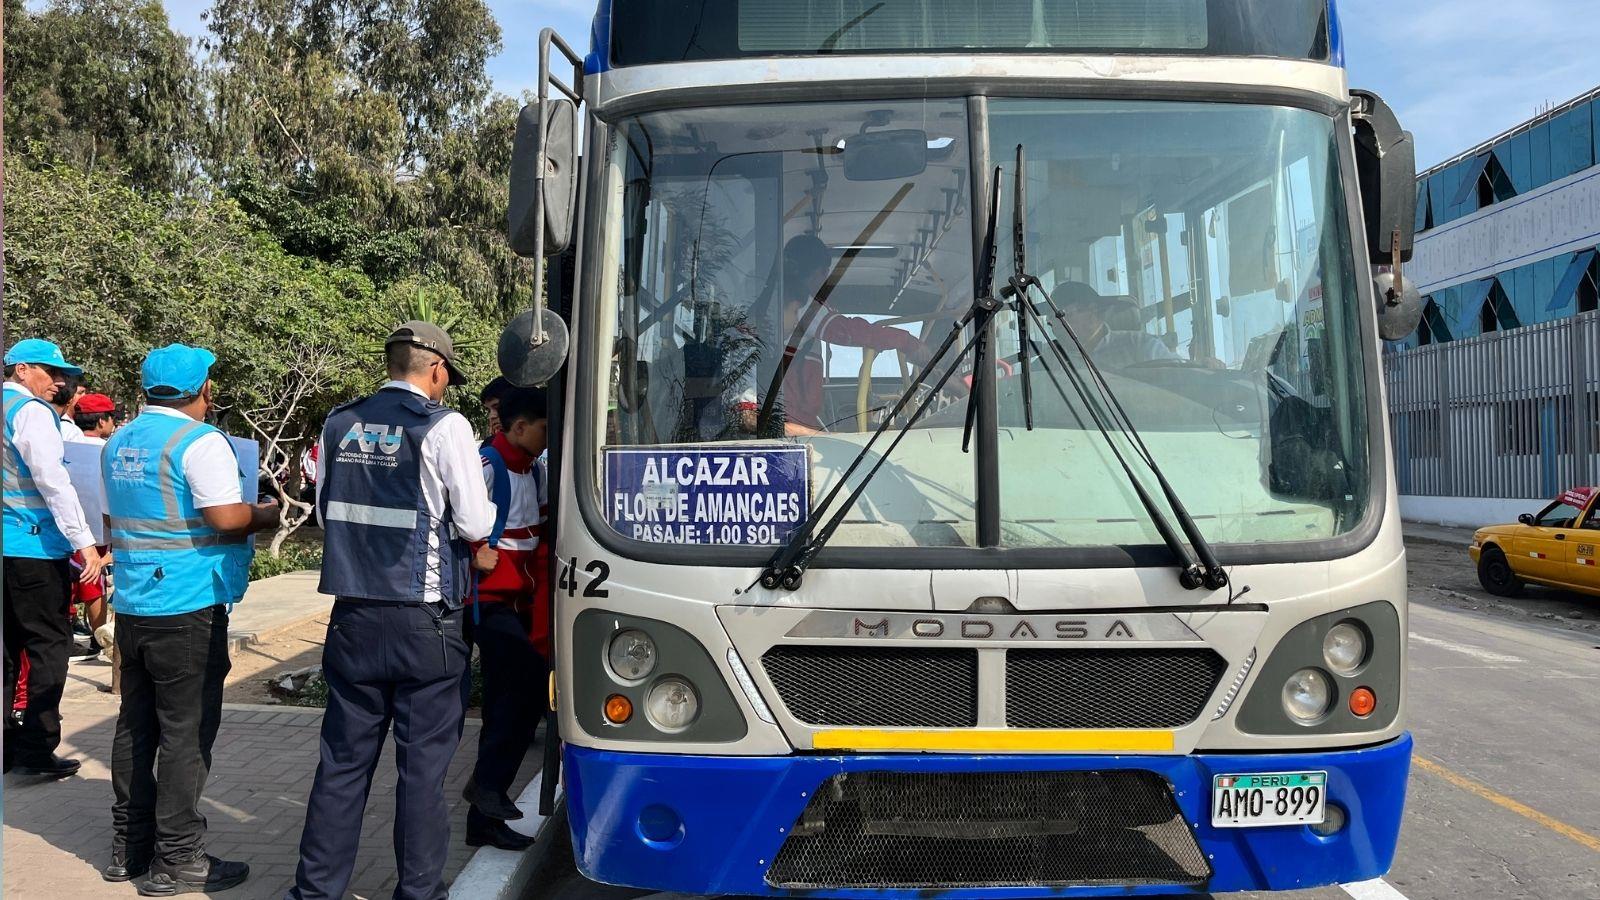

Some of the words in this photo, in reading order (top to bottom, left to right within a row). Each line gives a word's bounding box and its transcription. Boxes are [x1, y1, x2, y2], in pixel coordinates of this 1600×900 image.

[339, 422, 403, 454] ATU
[641, 457, 770, 486] ALCAZAR
[694, 492, 800, 523] AMANCAES
[633, 524, 700, 544] PASAJE:
[706, 525, 742, 544] 1.00
[746, 524, 781, 544] SOL
[559, 557, 610, 598] 42
[854, 618, 1133, 639] MODASA
[1251, 776, 1290, 787] PERU
[1218, 786, 1320, 818] AMO-899
